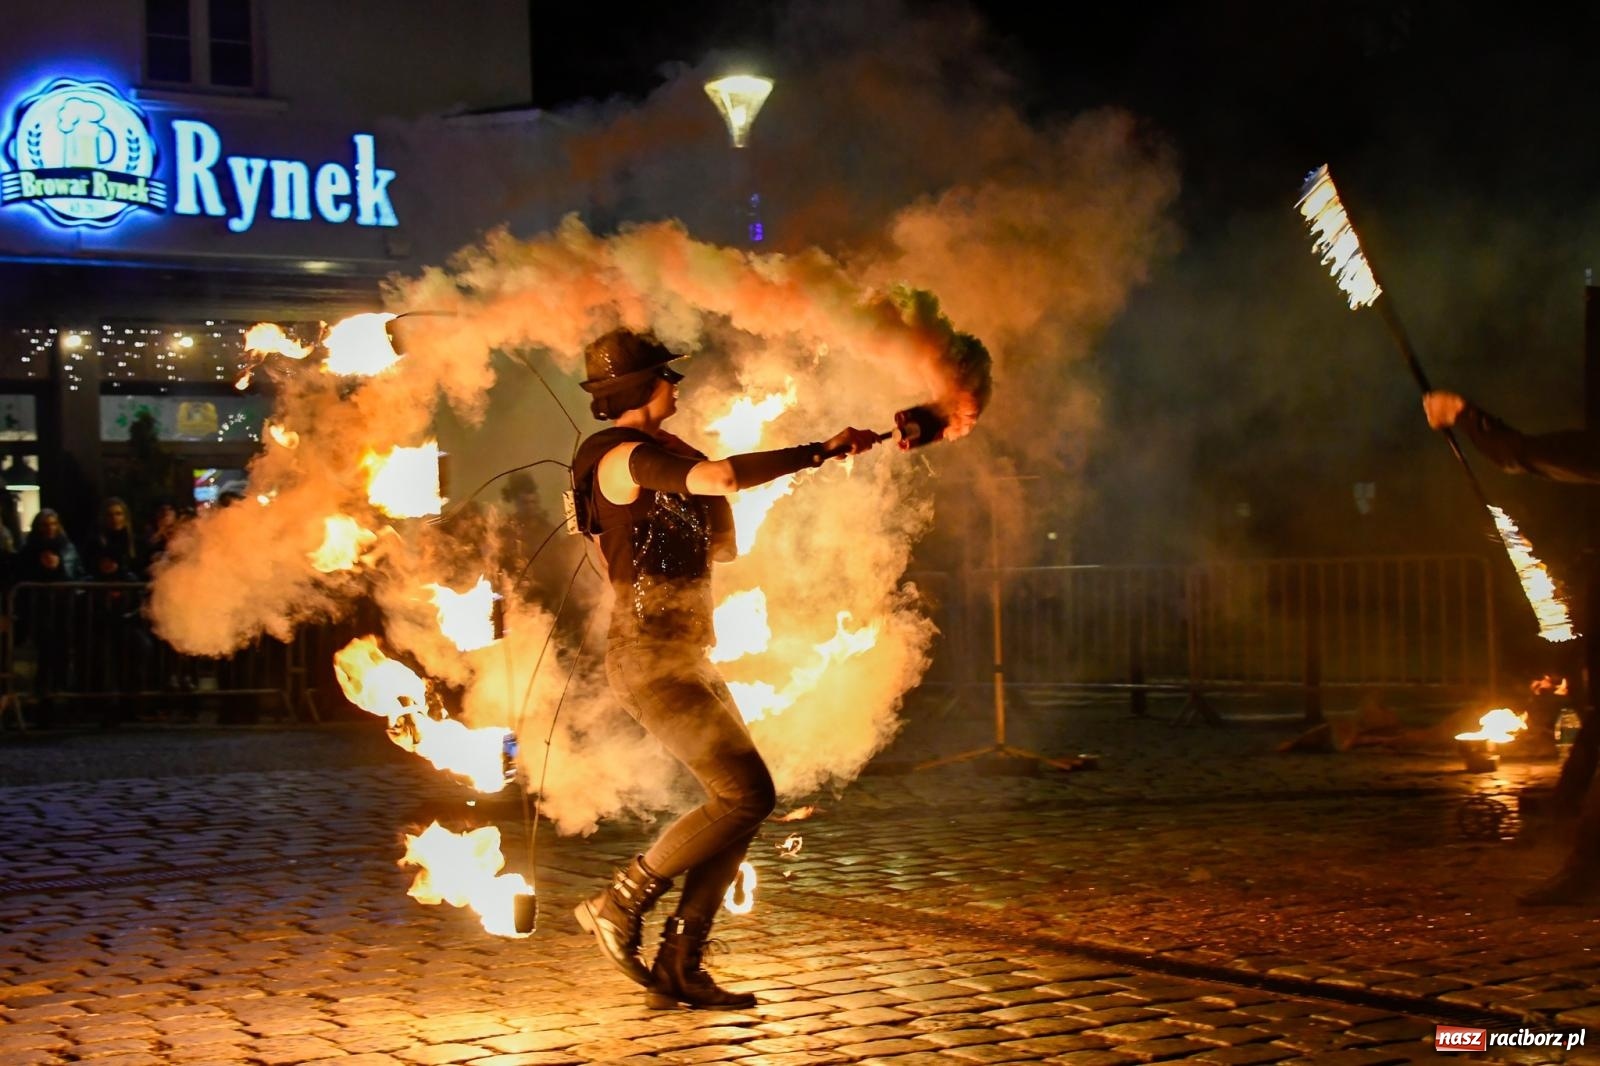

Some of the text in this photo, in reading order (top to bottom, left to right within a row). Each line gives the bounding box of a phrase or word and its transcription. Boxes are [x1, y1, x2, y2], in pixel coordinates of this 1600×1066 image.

[20, 171, 149, 203] Browar Rynek
[172, 120, 398, 232] Rynek
